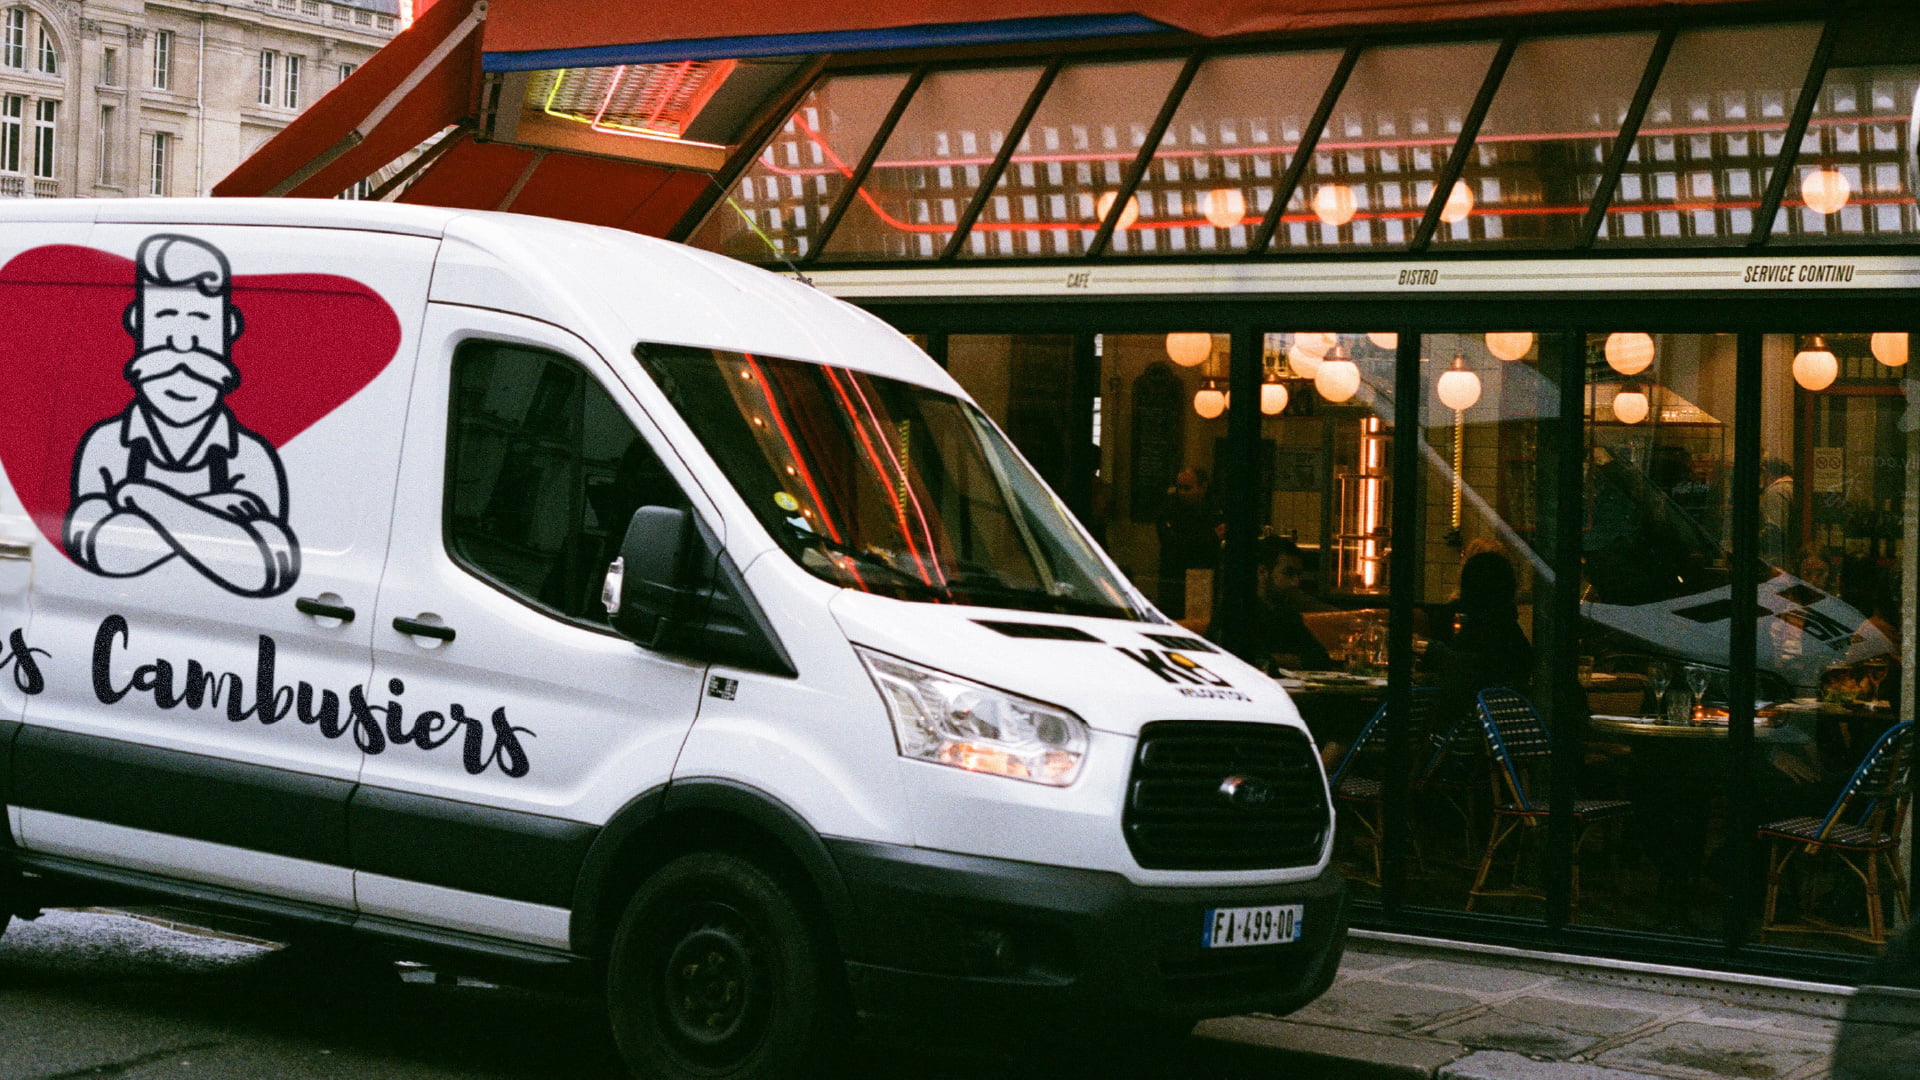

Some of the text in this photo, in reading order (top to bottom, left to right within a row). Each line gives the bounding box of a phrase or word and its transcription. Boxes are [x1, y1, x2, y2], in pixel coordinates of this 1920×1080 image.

[1398, 269, 1439, 285] BISTRO
[1744, 264, 1855, 283] SERVICE CONTINU
[92, 614, 536, 778] Cambusiers
